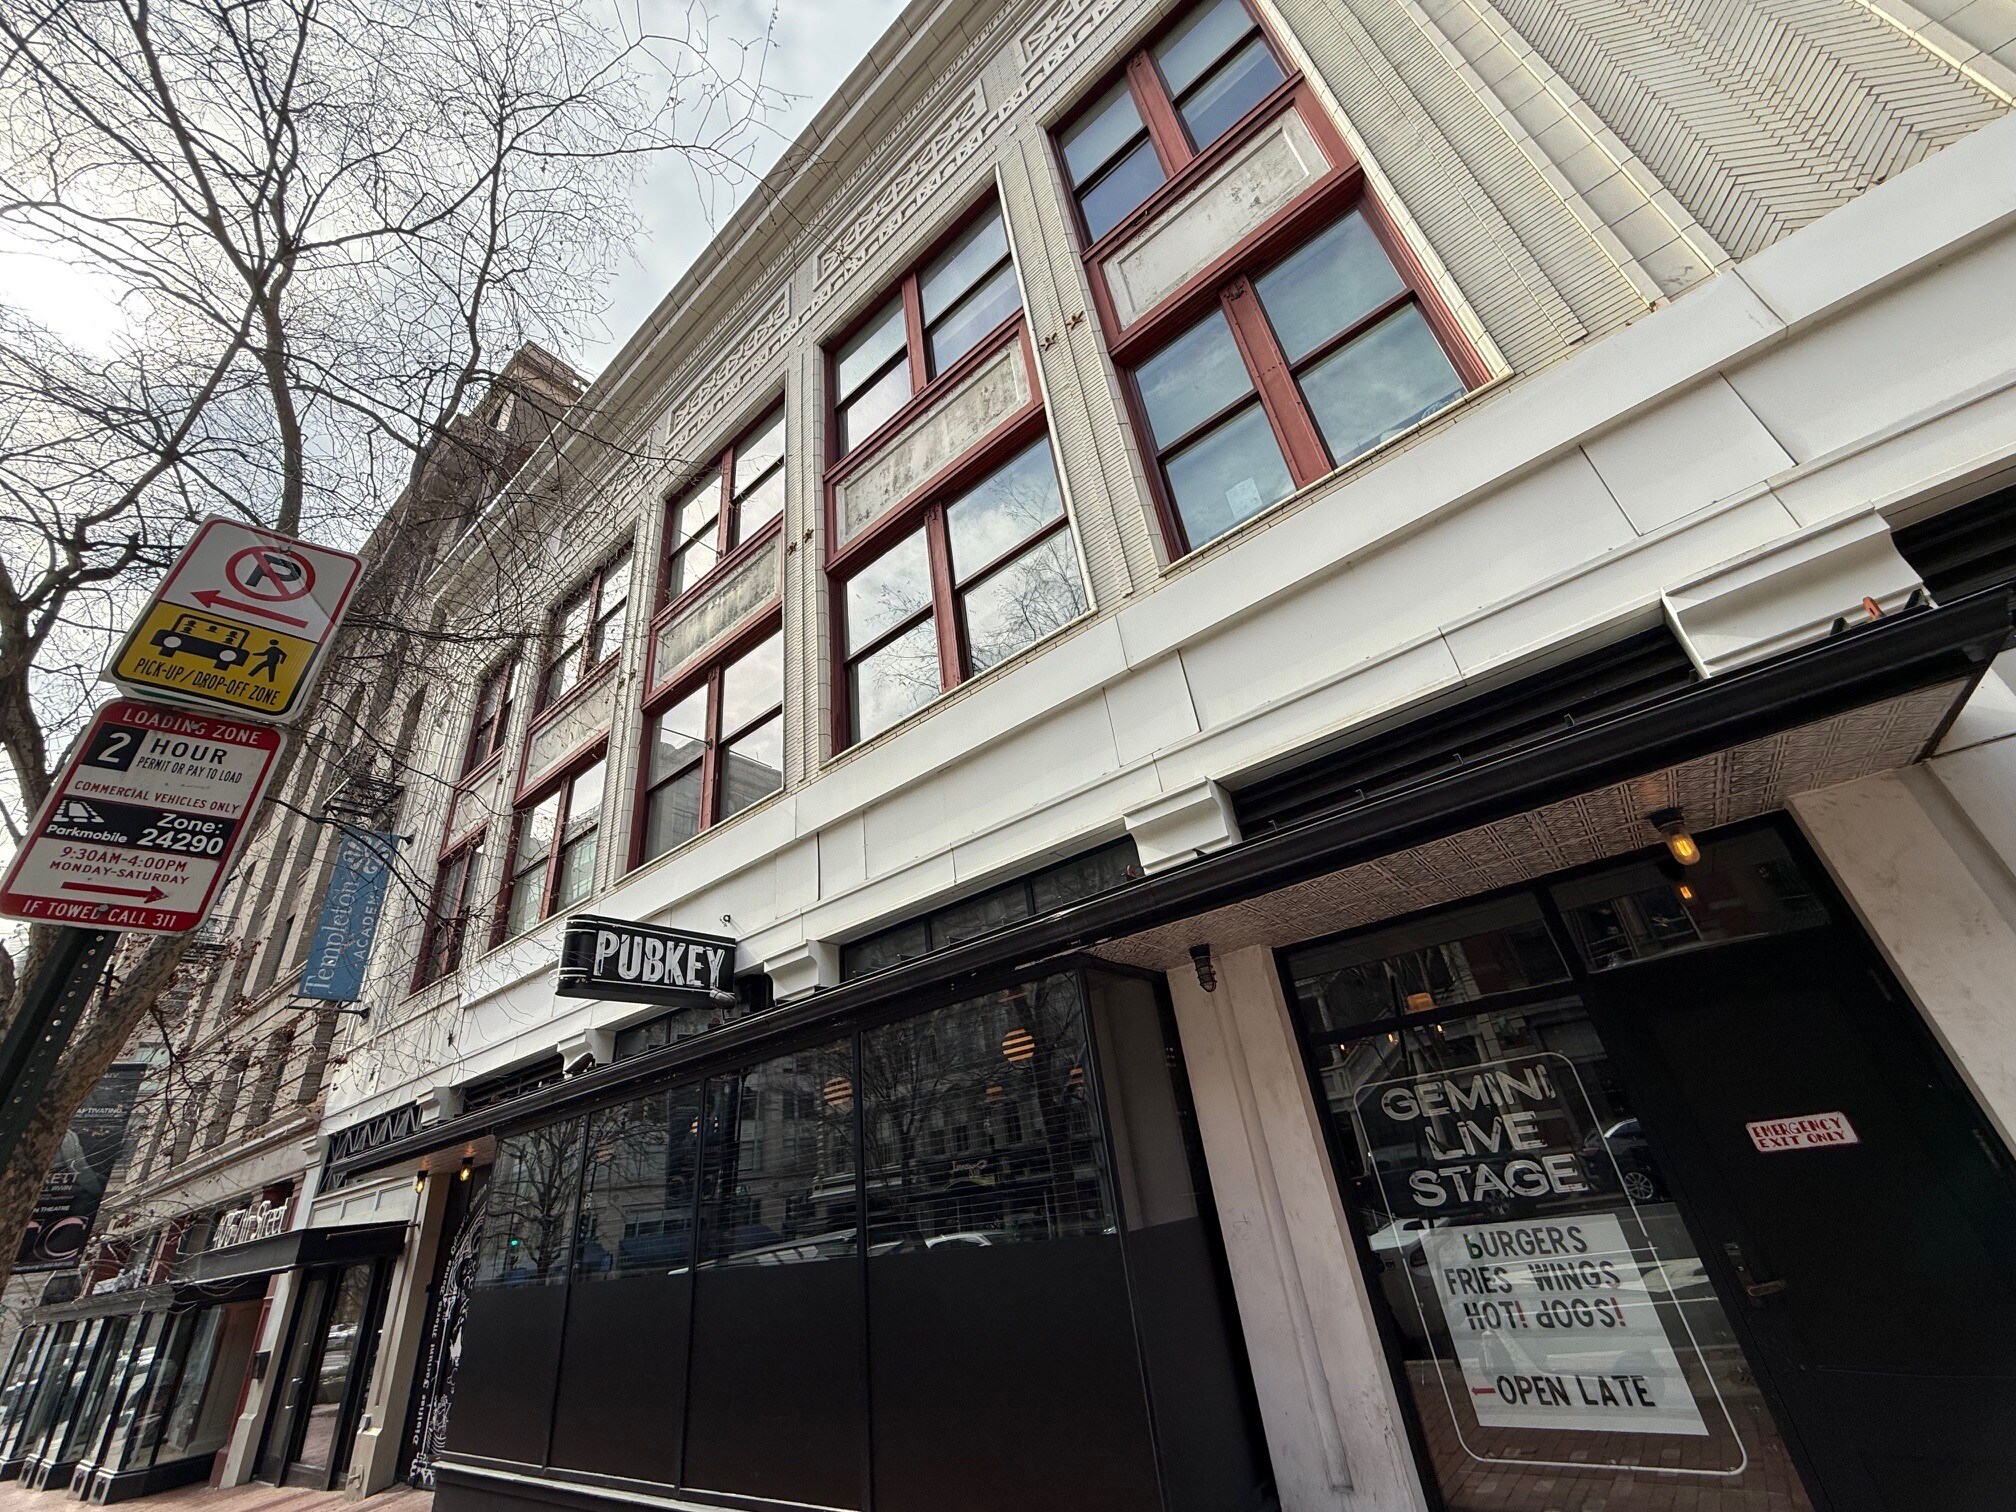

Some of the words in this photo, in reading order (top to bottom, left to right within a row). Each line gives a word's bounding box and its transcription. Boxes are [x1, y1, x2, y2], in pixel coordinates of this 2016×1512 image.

[248, 685, 281, 706] ZONE
[122, 708, 208, 735] LOADING
[212, 724, 262, 745] ZONE
[96, 732, 132, 763] 2
[150, 738, 228, 765] HOUR
[136, 756, 171, 773] PERMIT
[171, 762, 185, 775] OR
[186, 765, 206, 778] PAY
[206, 767, 220, 780] TO
[219, 770, 243, 784] LOAD
[74, 780, 150, 801] COMMERCIAL
[154, 792, 208, 809] VEHICLES
[209, 800, 240, 815] ONLY
[46, 824, 128, 844] Parkmobile
[156, 812, 224, 835] Zone:
[136, 828, 224, 855] 24290
[49, 860, 190, 885] MONDAY-SATURDAY
[60, 846, 188, 873] 9:30AM-4:00PM
[21, 899, 39, 914] IF
[48, 902, 105, 921] TOWED
[106, 908, 147, 925] CALL
[152, 913, 177, 928] 311
[302, 880, 360, 995] Templeton
[593, 929, 726, 989] PUBKEY
[1381, 1064, 1557, 1121] GEMINI
[1424, 1110, 1548, 1161] LIVE
[1751, 1116, 1842, 1138] EMERGENCY
[1757, 1135, 1801, 1149] EXIT
[1806, 1130, 1846, 1144] ONLY
[1408, 1152, 1590, 1207] STAGE
[250, 1197, 288, 1241] Street
[1443, 1266, 1512, 1296] FRIES
[1528, 1260, 1621, 1291] WINGS
[1463, 1300, 1529, 1330] HOT!
[1496, 1375, 1572, 1407] OPEN
[1575, 1374, 1656, 1407] LATE
